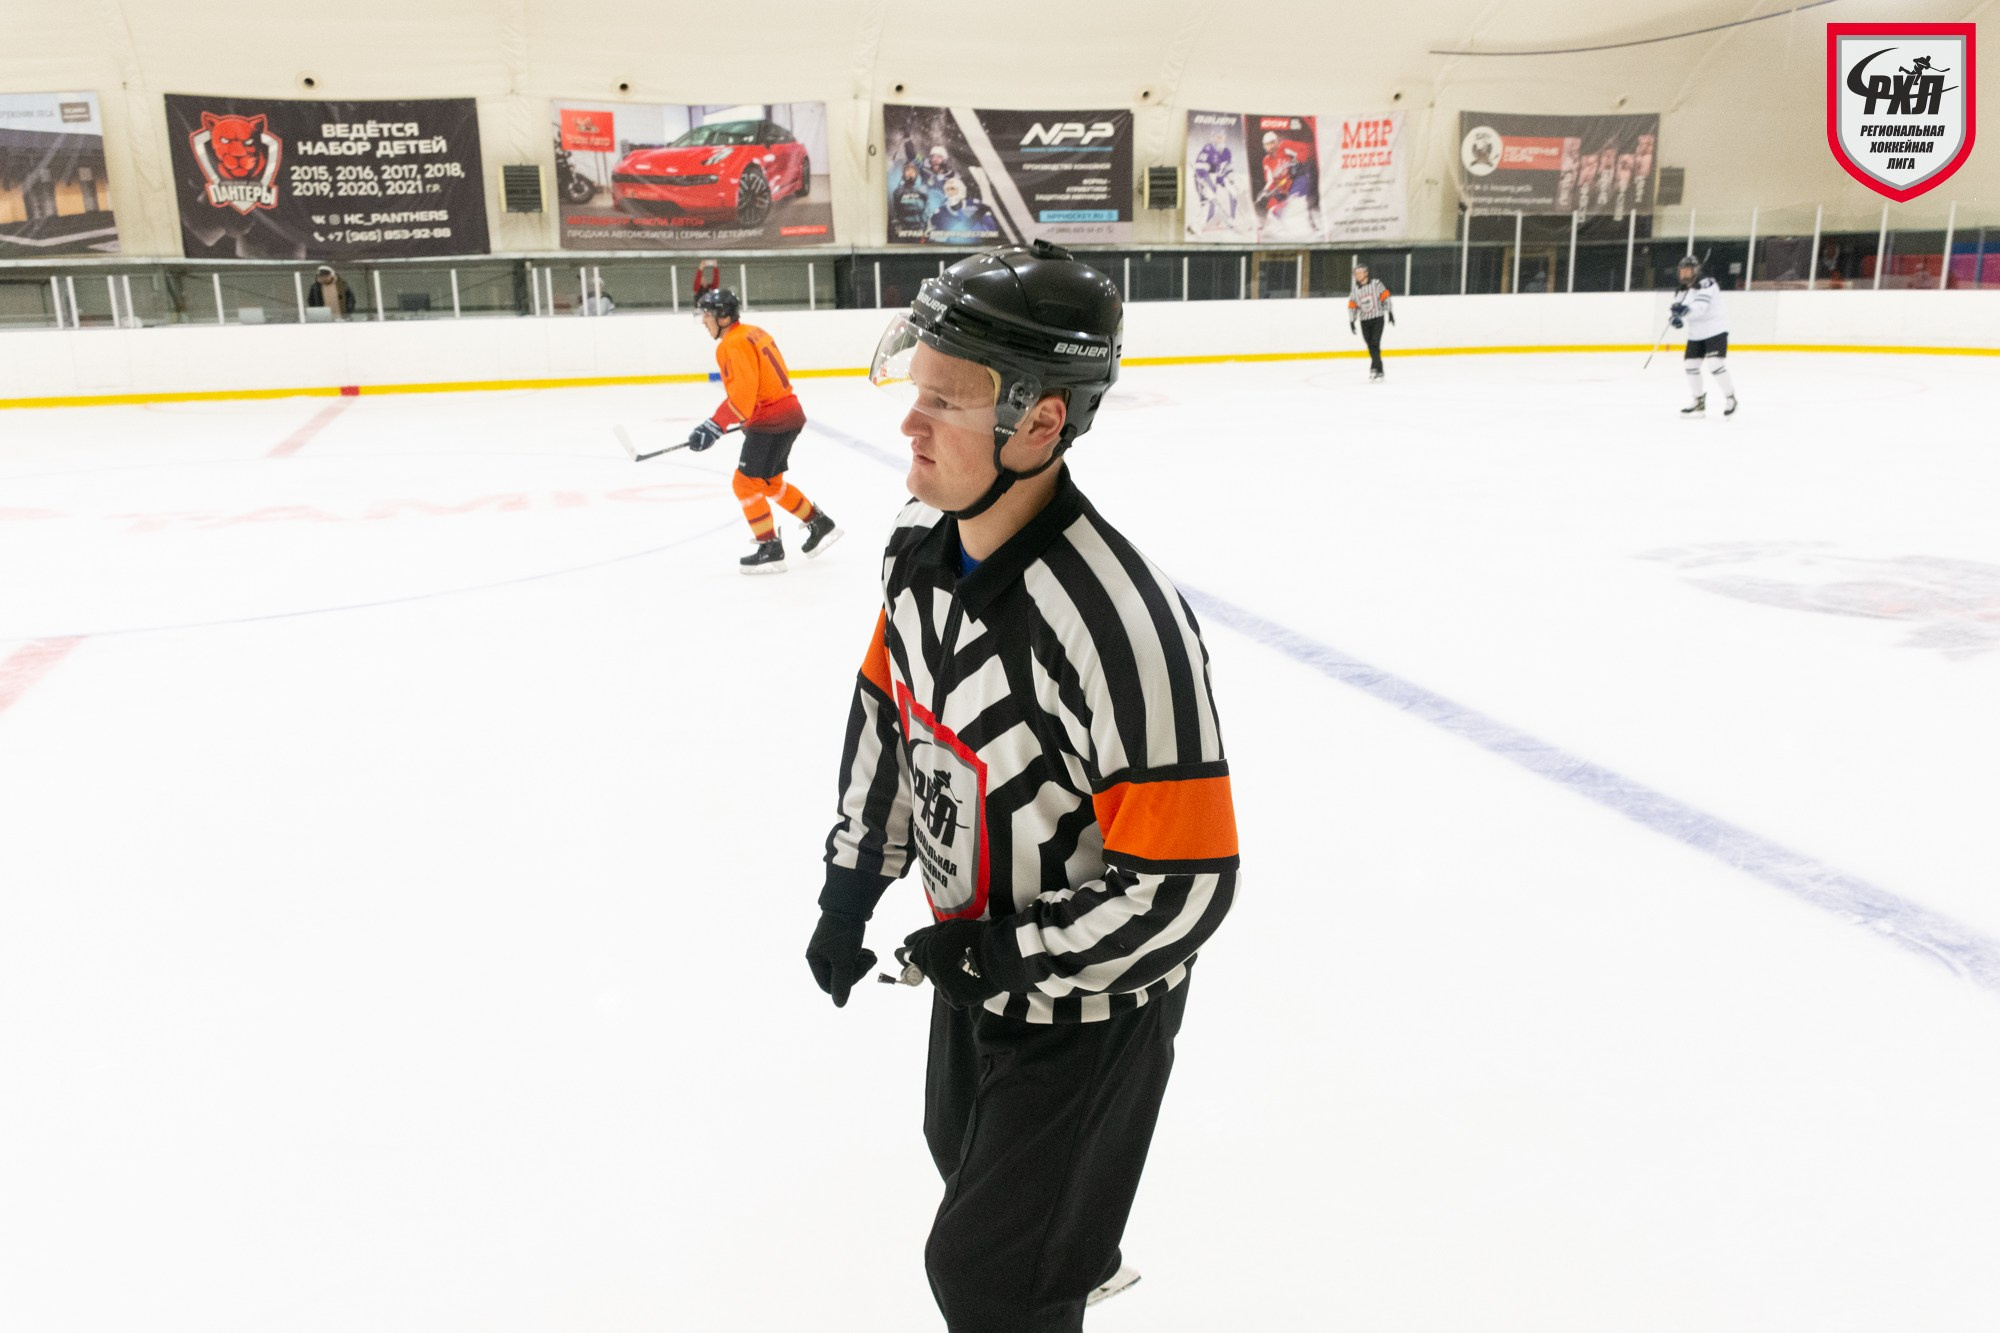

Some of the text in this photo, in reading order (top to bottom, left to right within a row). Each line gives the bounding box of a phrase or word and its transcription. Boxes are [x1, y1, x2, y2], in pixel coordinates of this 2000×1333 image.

[321, 120, 419, 140] ВЕДЁТСЯ
[1019, 122, 1115, 146] NPP
[1341, 119, 1394, 150] МИР
[297, 136, 447, 158] НАБОР ДЕТЕЙ
[290, 163, 465, 181] 2015, 2016, 2017, 2018,
[209, 185, 276, 204] ПАНТЕРЫ
[292, 182, 334, 198] 2019,
[337, 182, 382, 197] 2020,
[386, 180, 423, 195] 2021
[344, 210, 448, 226] HC_PANTHERS
[328, 231, 343, 241] +7
[1054, 342, 1109, 358] BAUER
